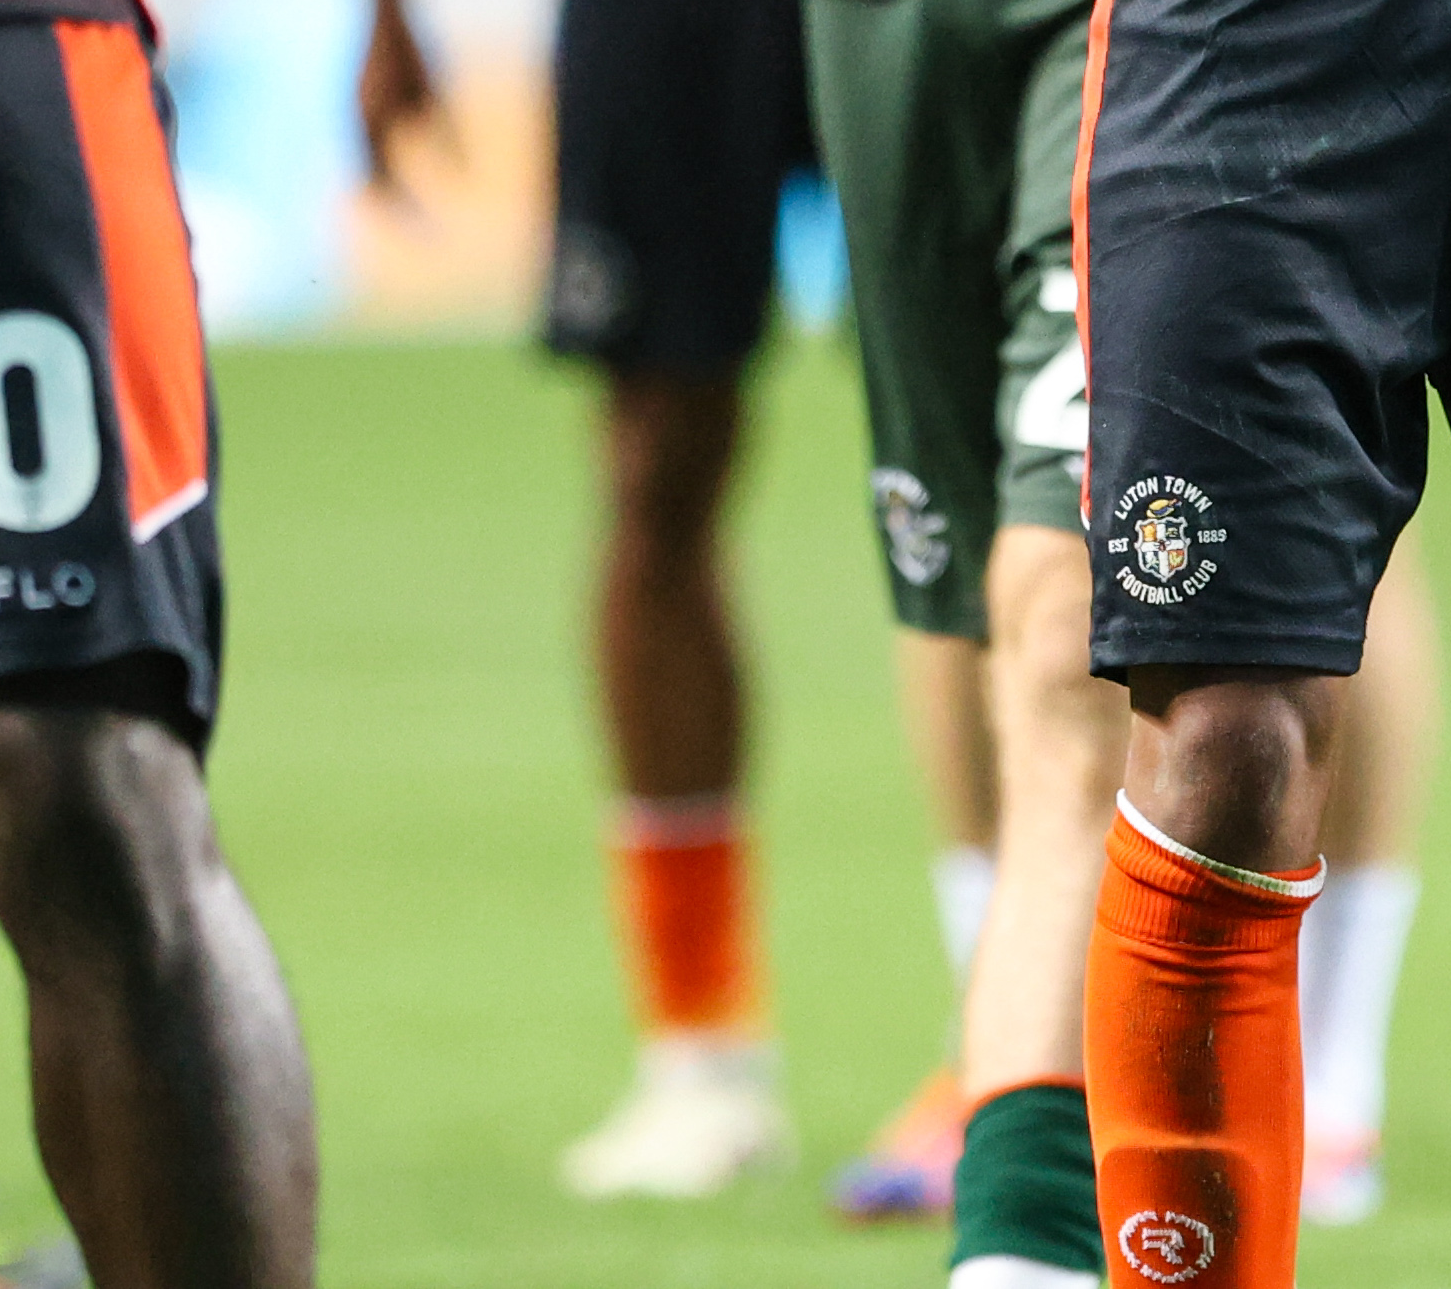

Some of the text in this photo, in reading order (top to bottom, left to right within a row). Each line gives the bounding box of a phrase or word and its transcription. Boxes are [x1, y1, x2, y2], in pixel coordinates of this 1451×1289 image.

[1114, 475, 1213, 520] LUTON TOWN
[1108, 537, 1129, 554] EST
[1116, 559, 1217, 605] FOOTBALL CLUB
